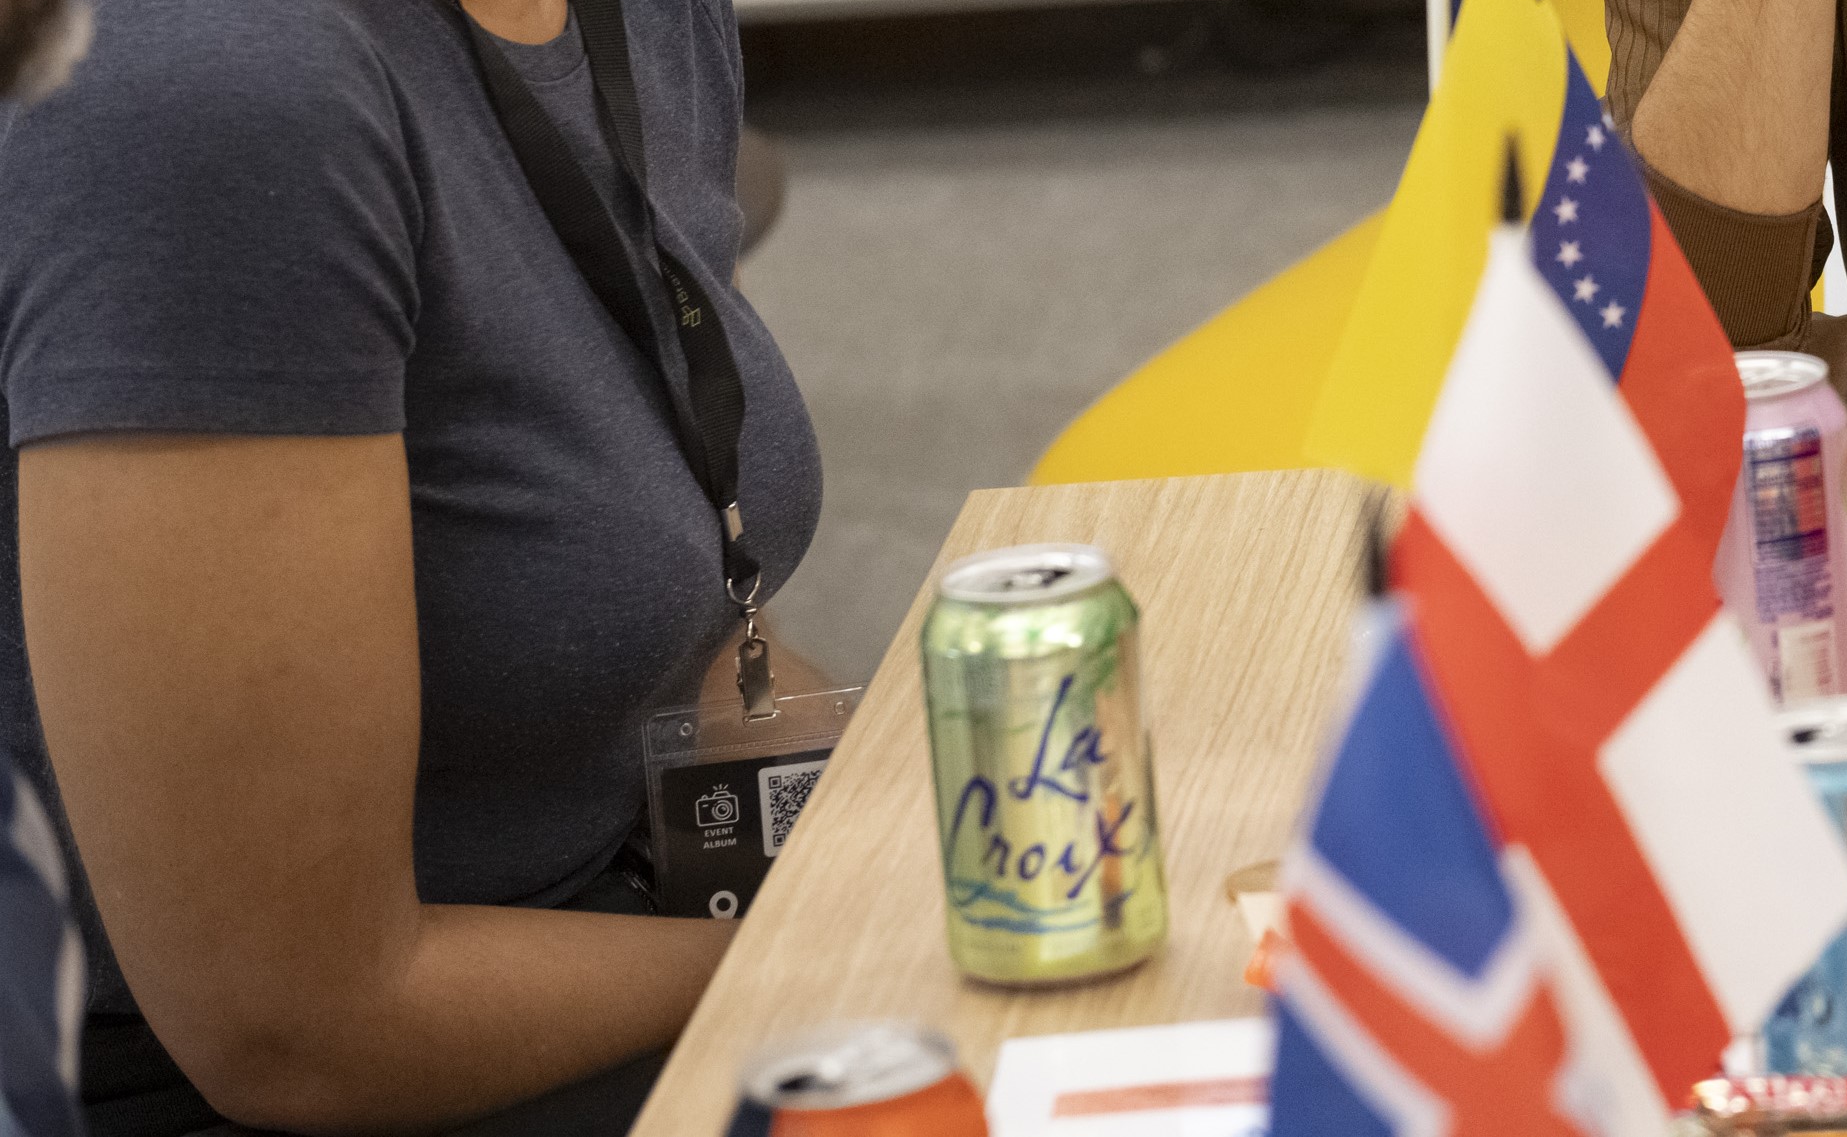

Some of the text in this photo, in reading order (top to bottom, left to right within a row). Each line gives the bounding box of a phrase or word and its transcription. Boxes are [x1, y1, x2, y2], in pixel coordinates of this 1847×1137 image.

[1009, 673, 1107, 801] La
[703, 838, 737, 849] ALBUM
[704, 827, 734, 837] EVENT
[945, 775, 1134, 900] Croix
